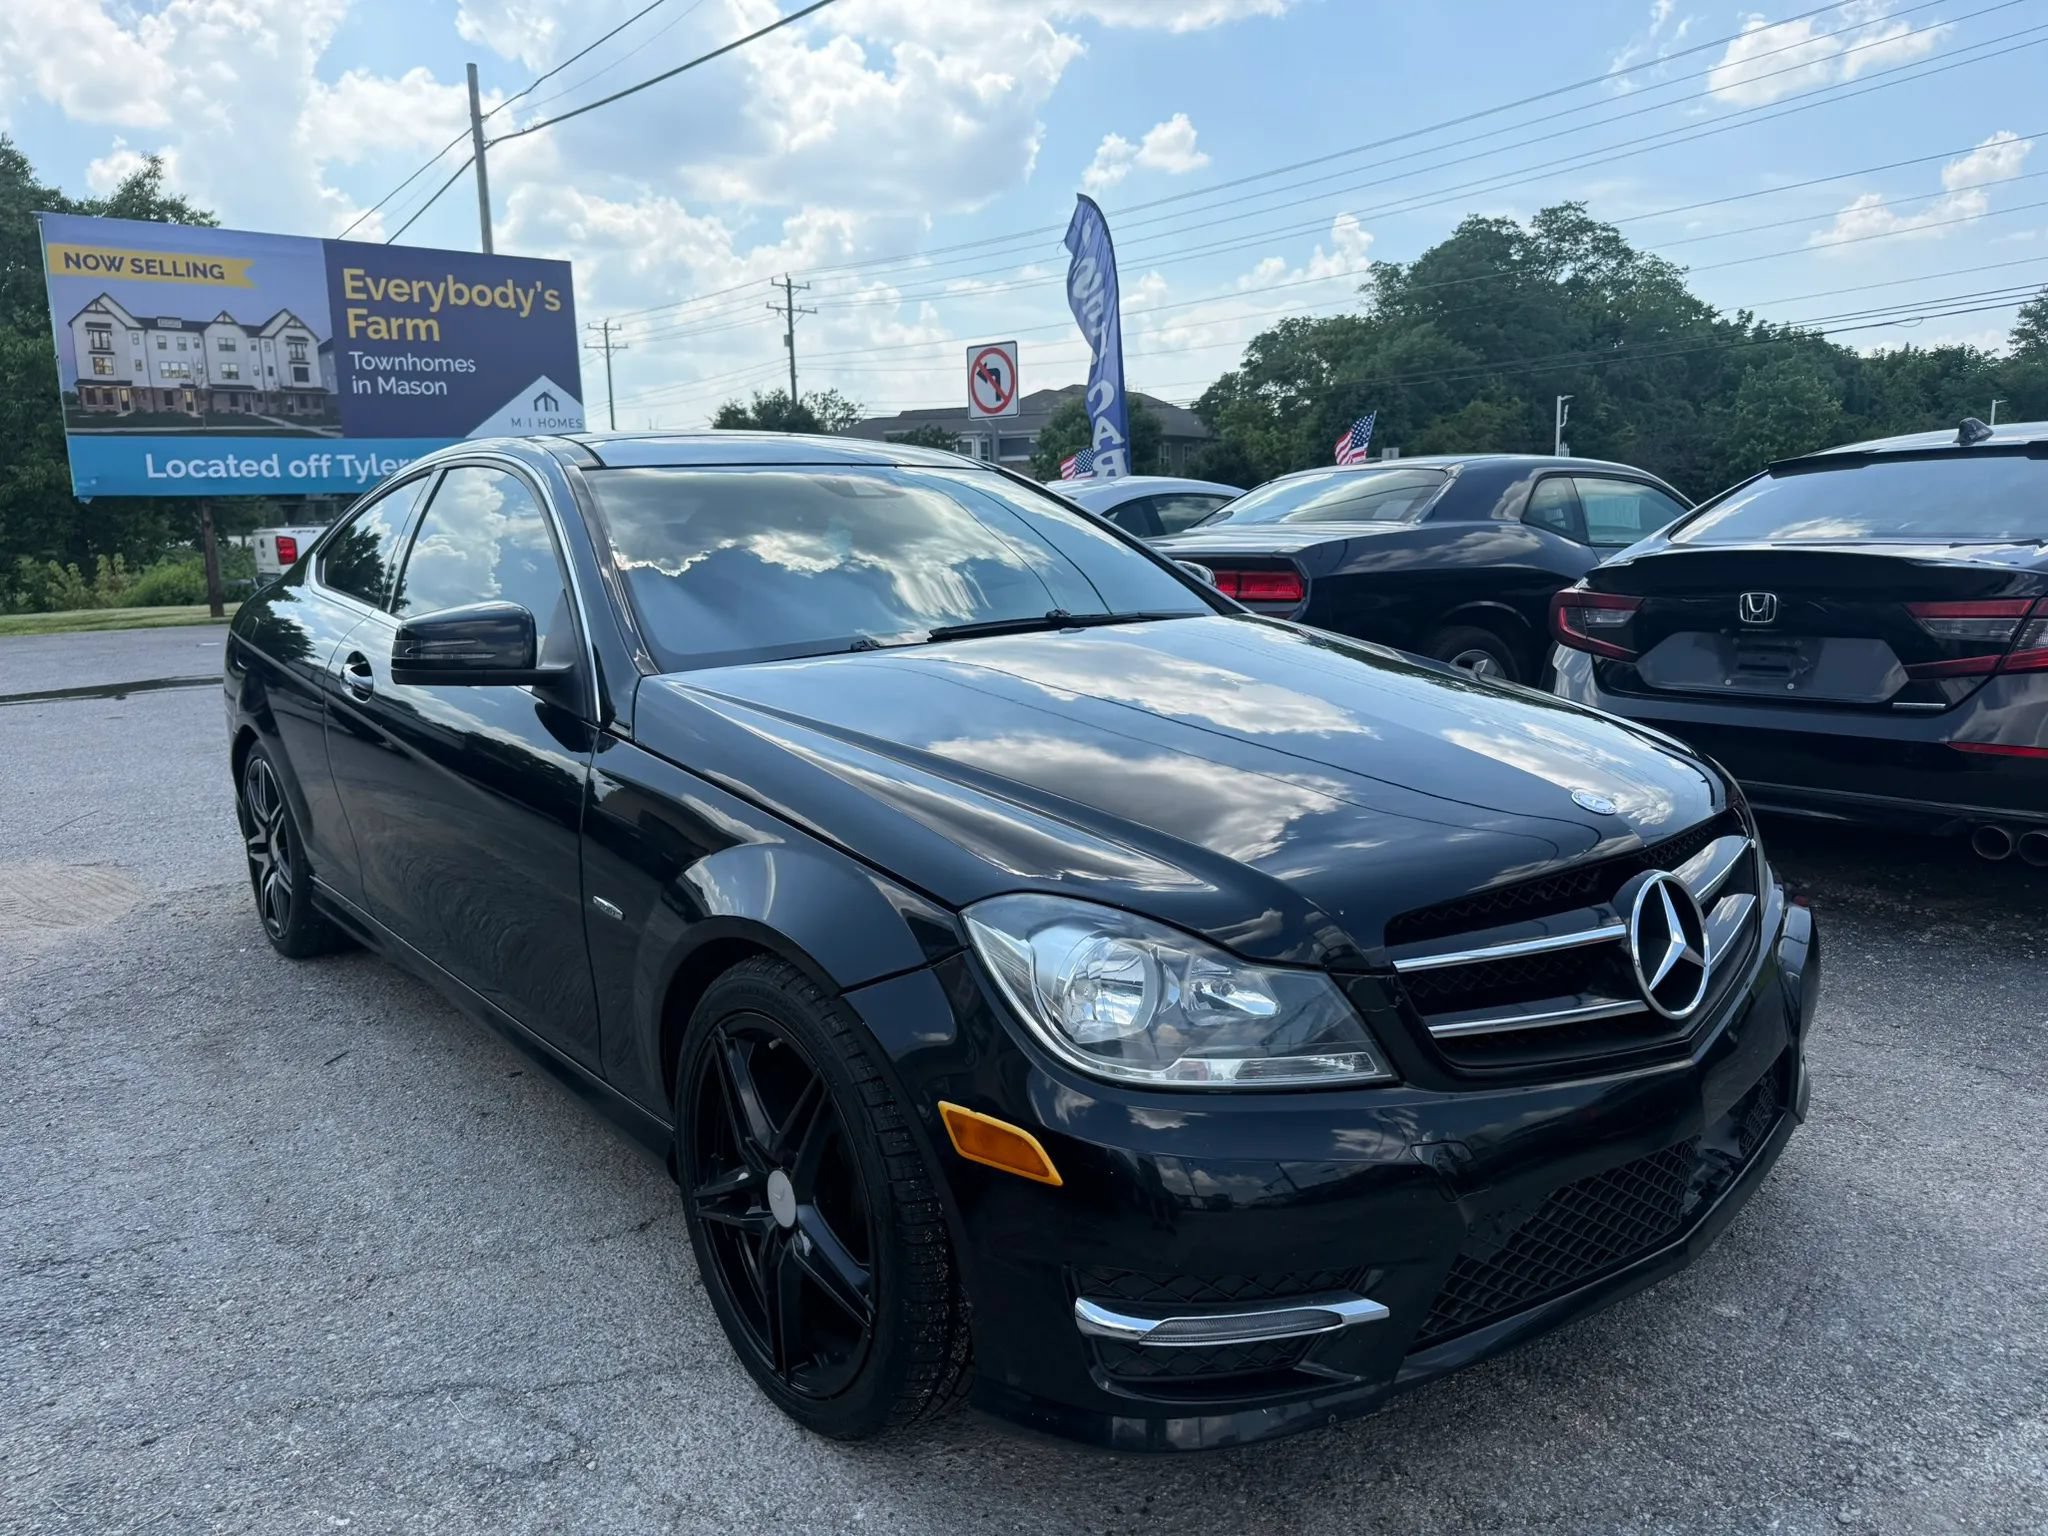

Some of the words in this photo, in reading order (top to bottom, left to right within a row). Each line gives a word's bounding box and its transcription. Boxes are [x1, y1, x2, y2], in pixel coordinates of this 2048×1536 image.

[64, 251, 124, 273] NOW
[130, 257, 225, 281] SELLING
[343, 267, 562, 319] Everybody's
[346, 307, 441, 342] Farm
[348, 351, 477, 374] Townhomes
[351, 375, 372, 395] in
[377, 376, 448, 396] Mason
[538, 417, 584, 429] HOMES
[145, 453, 281, 479] Located
[288, 453, 332, 479] off
